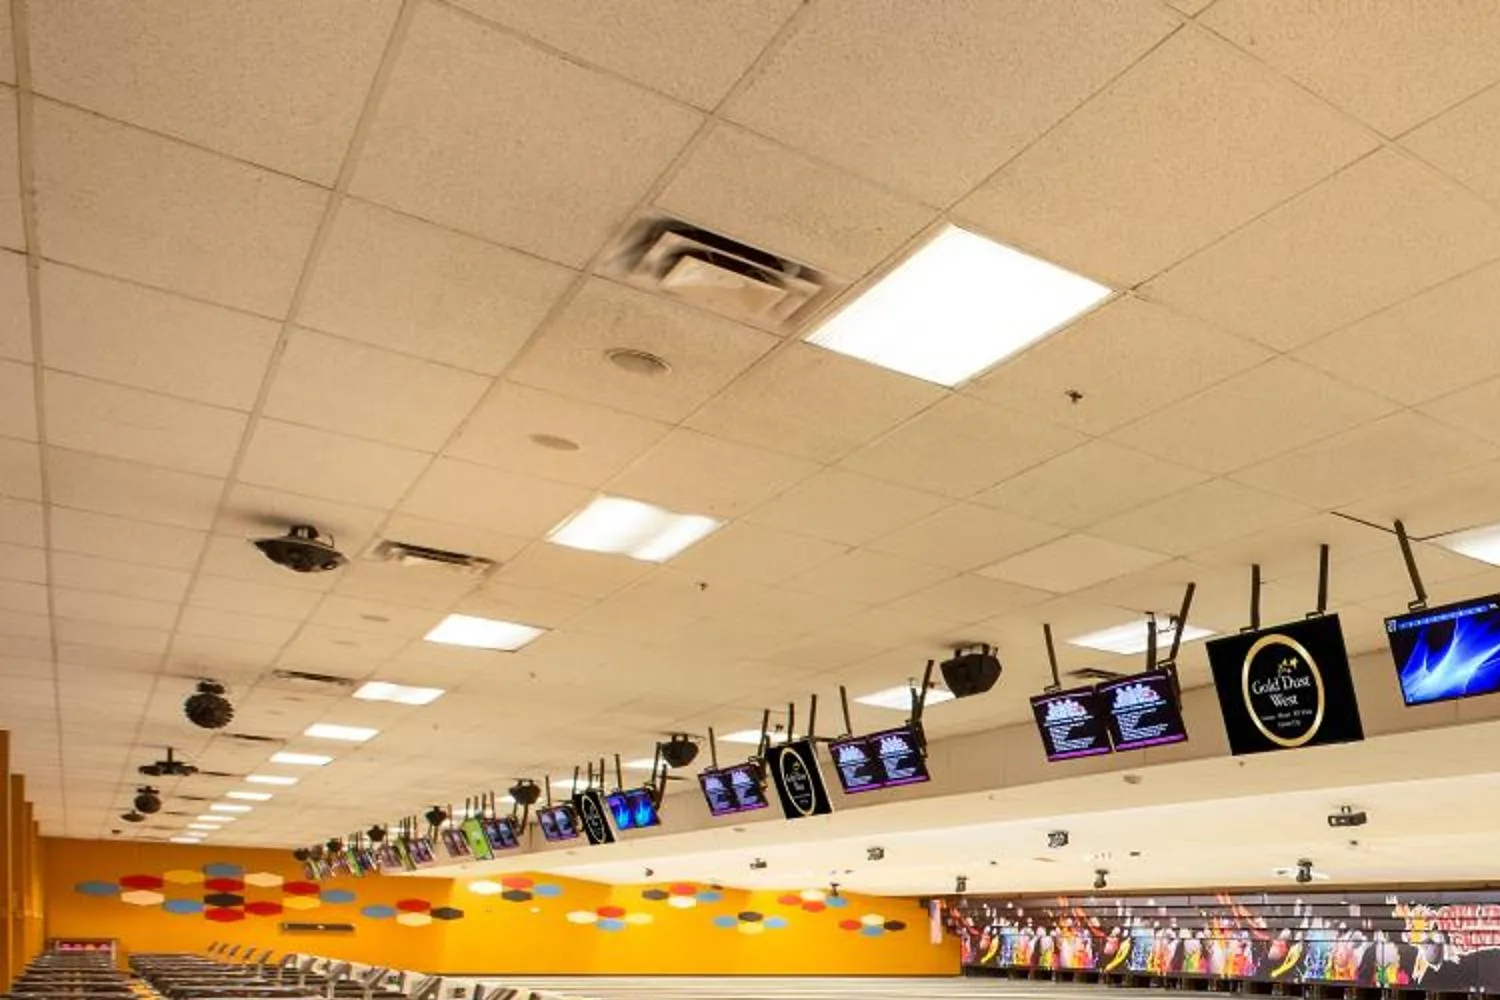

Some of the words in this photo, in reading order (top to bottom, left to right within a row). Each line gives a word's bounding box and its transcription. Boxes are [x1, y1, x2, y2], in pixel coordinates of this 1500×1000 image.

[1252, 677, 1280, 695] Gold
[1282, 675, 1311, 690] Dust
[1269, 693, 1299, 707] West
